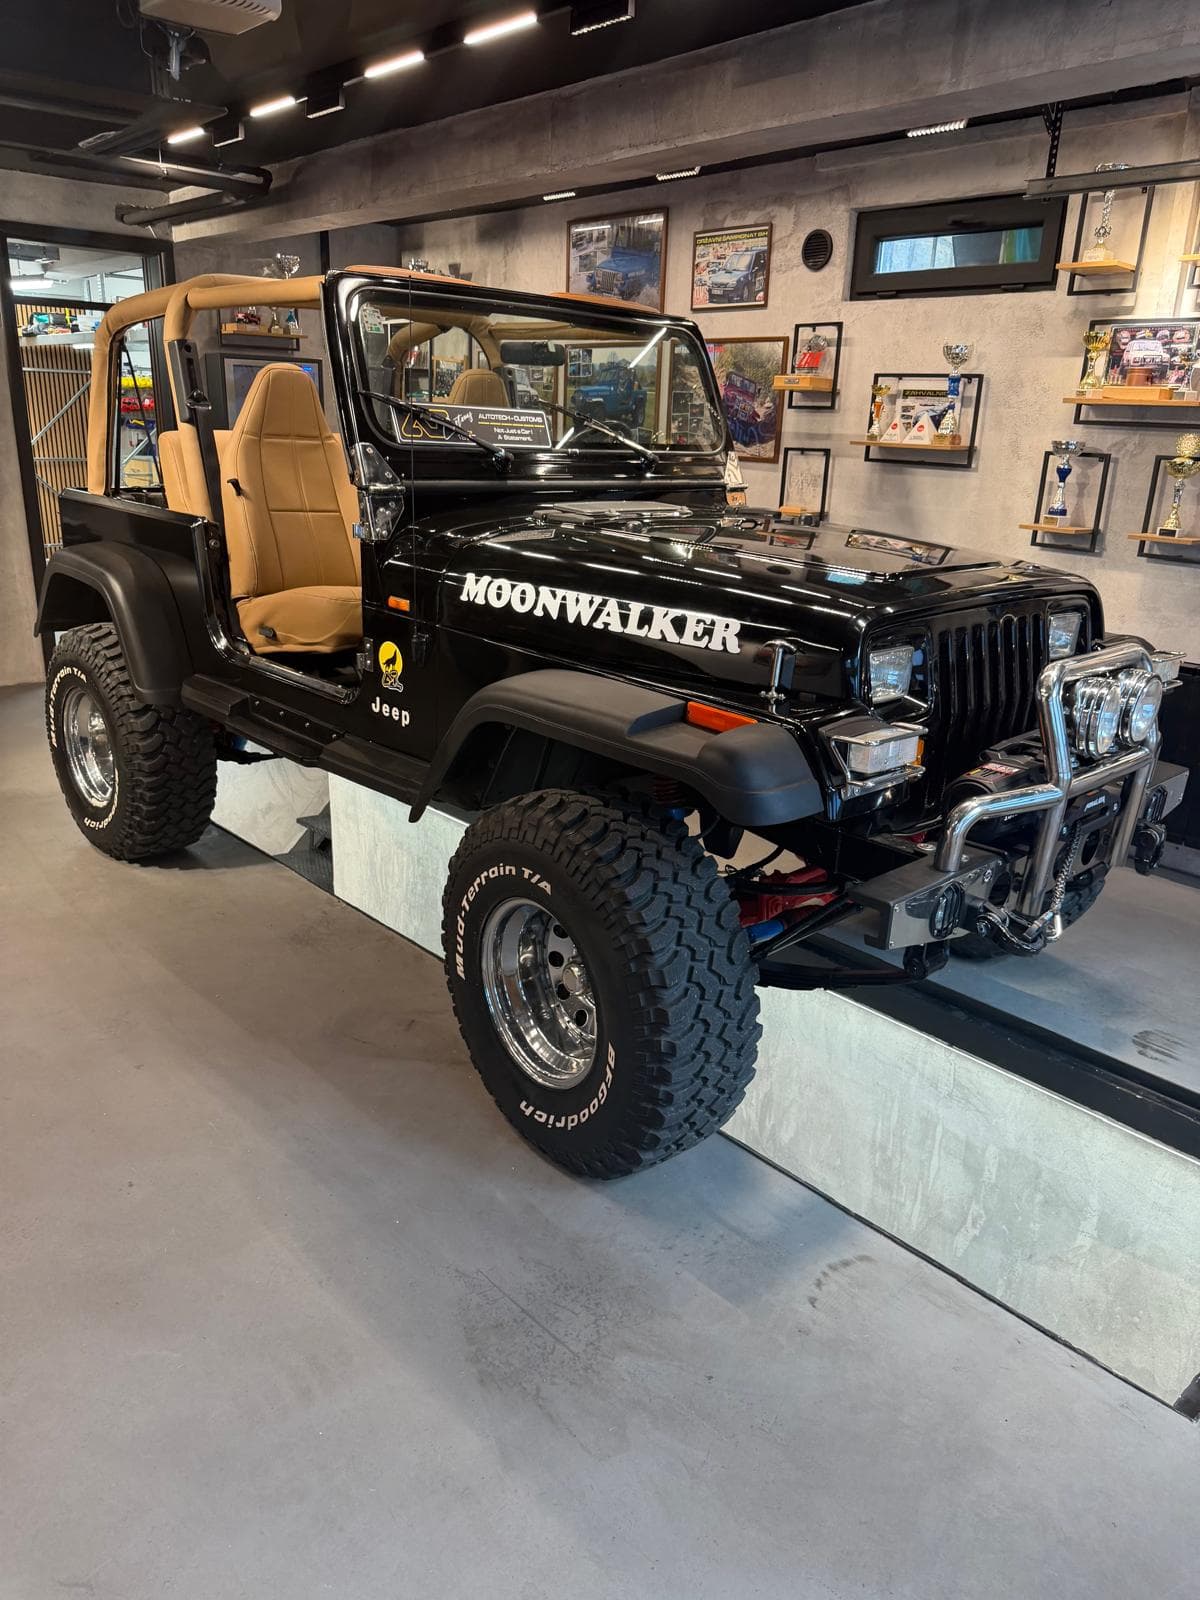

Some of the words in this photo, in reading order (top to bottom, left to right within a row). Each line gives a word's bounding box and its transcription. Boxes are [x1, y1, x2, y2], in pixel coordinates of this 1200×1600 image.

[460, 573, 741, 653] MOONWALKER
[371, 696, 410, 727] Jeep
[455, 863, 517, 980] Mud-Terrain
[521, 867, 552, 896] T/A
[519, 1040, 616, 1131] BFGoodrich
